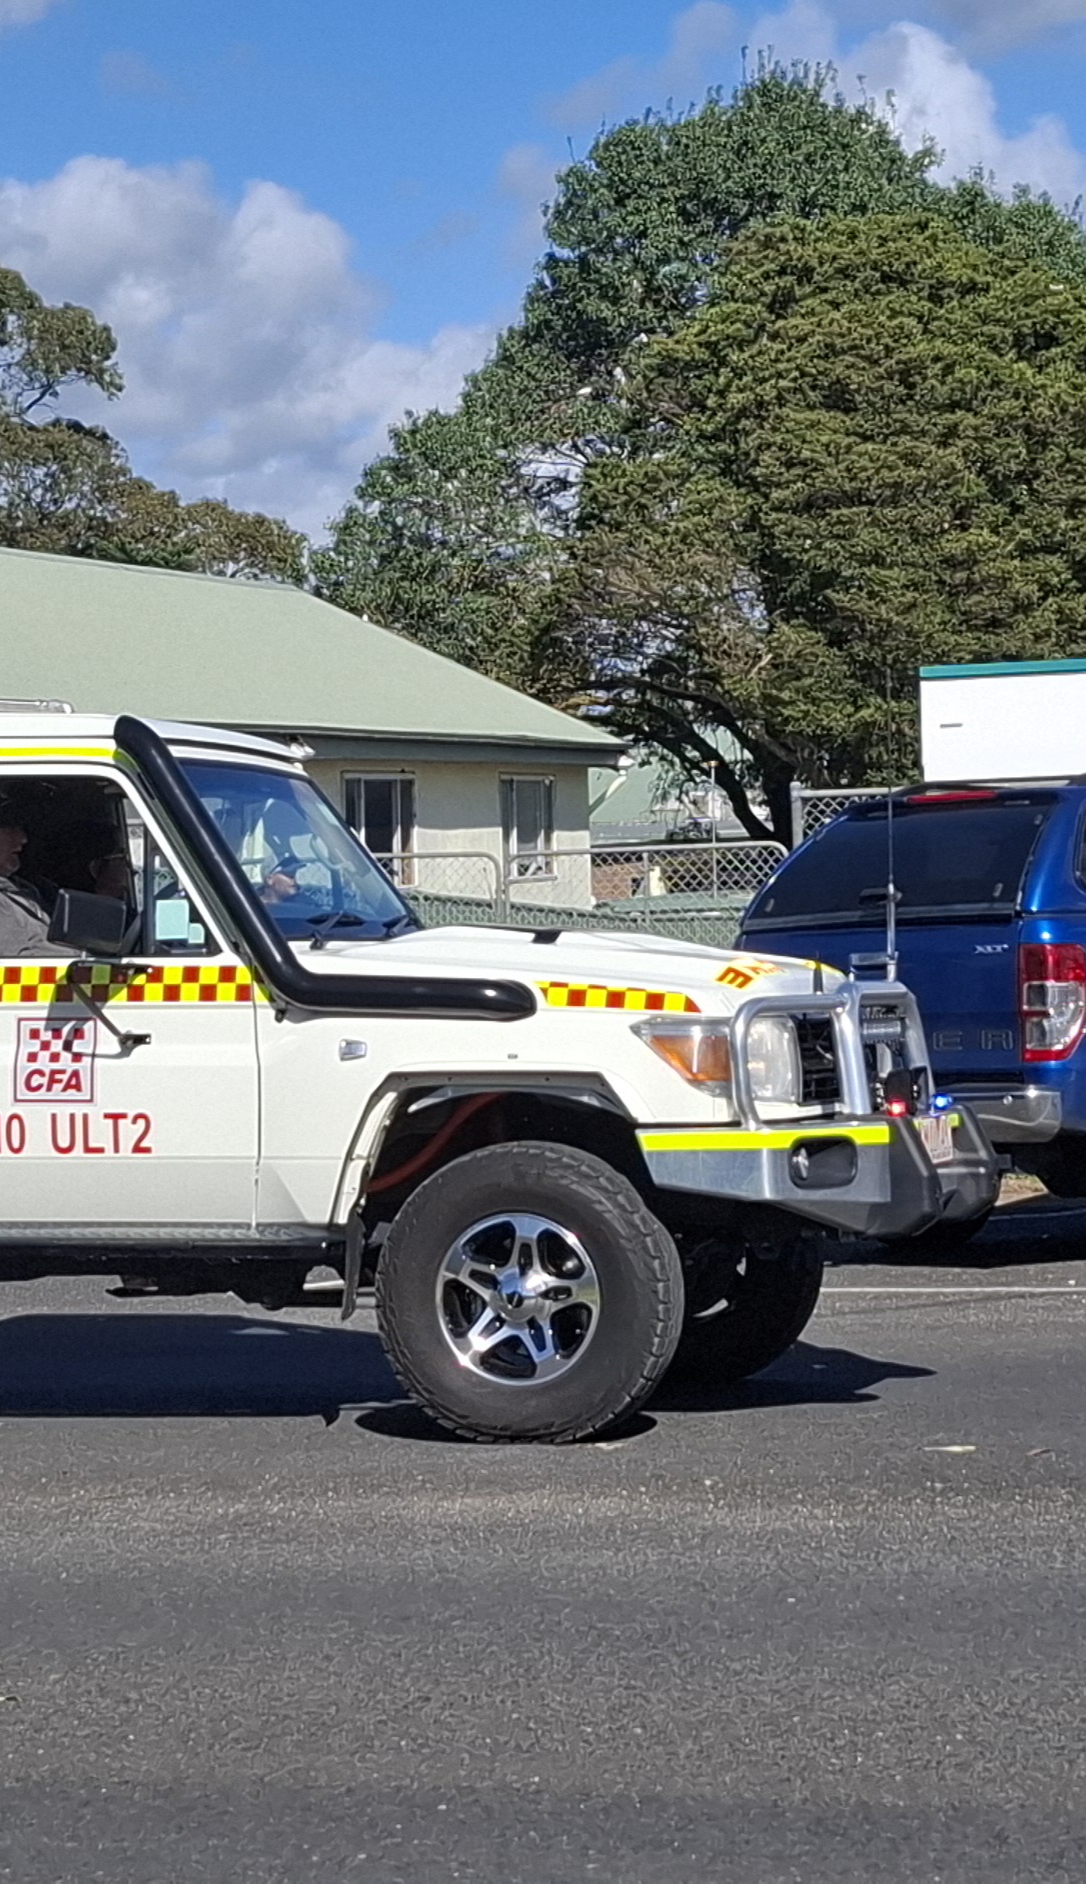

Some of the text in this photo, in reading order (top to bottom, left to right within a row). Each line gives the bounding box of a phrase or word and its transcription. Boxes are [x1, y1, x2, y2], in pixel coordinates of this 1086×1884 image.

[974, 944, 1009, 954] XLT
[24, 1069, 83, 1093] CFA
[50, 1112, 153, 1154] ULT2
